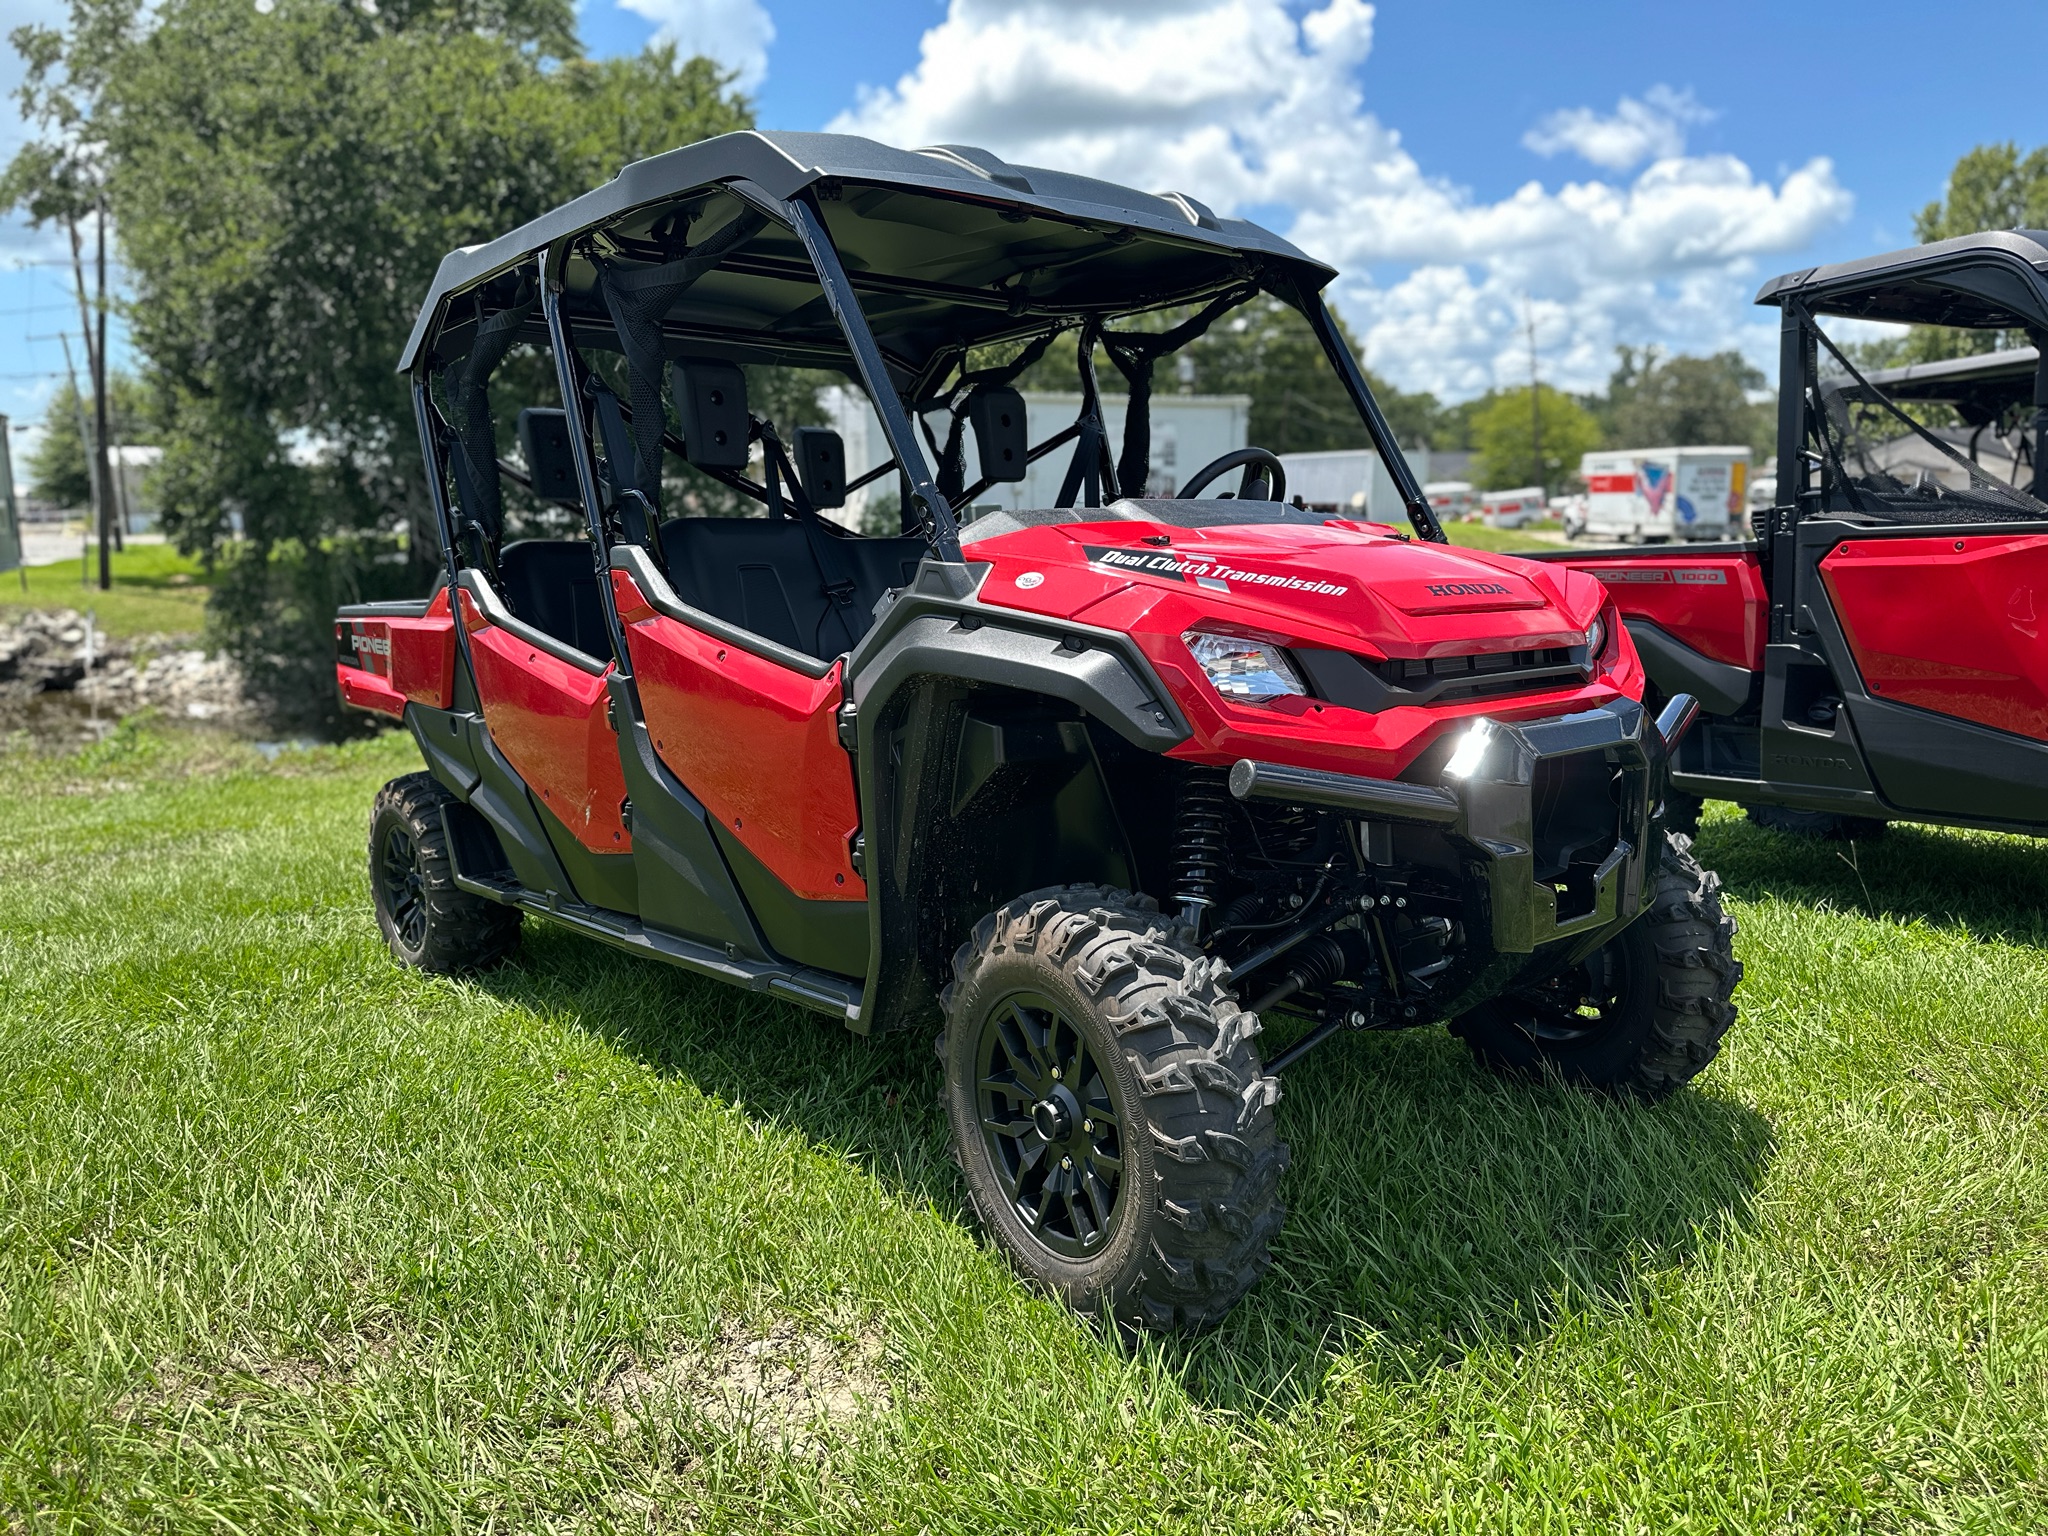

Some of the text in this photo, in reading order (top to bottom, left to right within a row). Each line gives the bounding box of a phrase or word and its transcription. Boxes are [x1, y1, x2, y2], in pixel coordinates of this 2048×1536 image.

[1099, 550, 1348, 596] Dual Clutch Transmission
[1681, 573, 1719, 581] 1000
[1425, 583, 1513, 597] HONDA
[1770, 753, 1852, 770] HONDA
